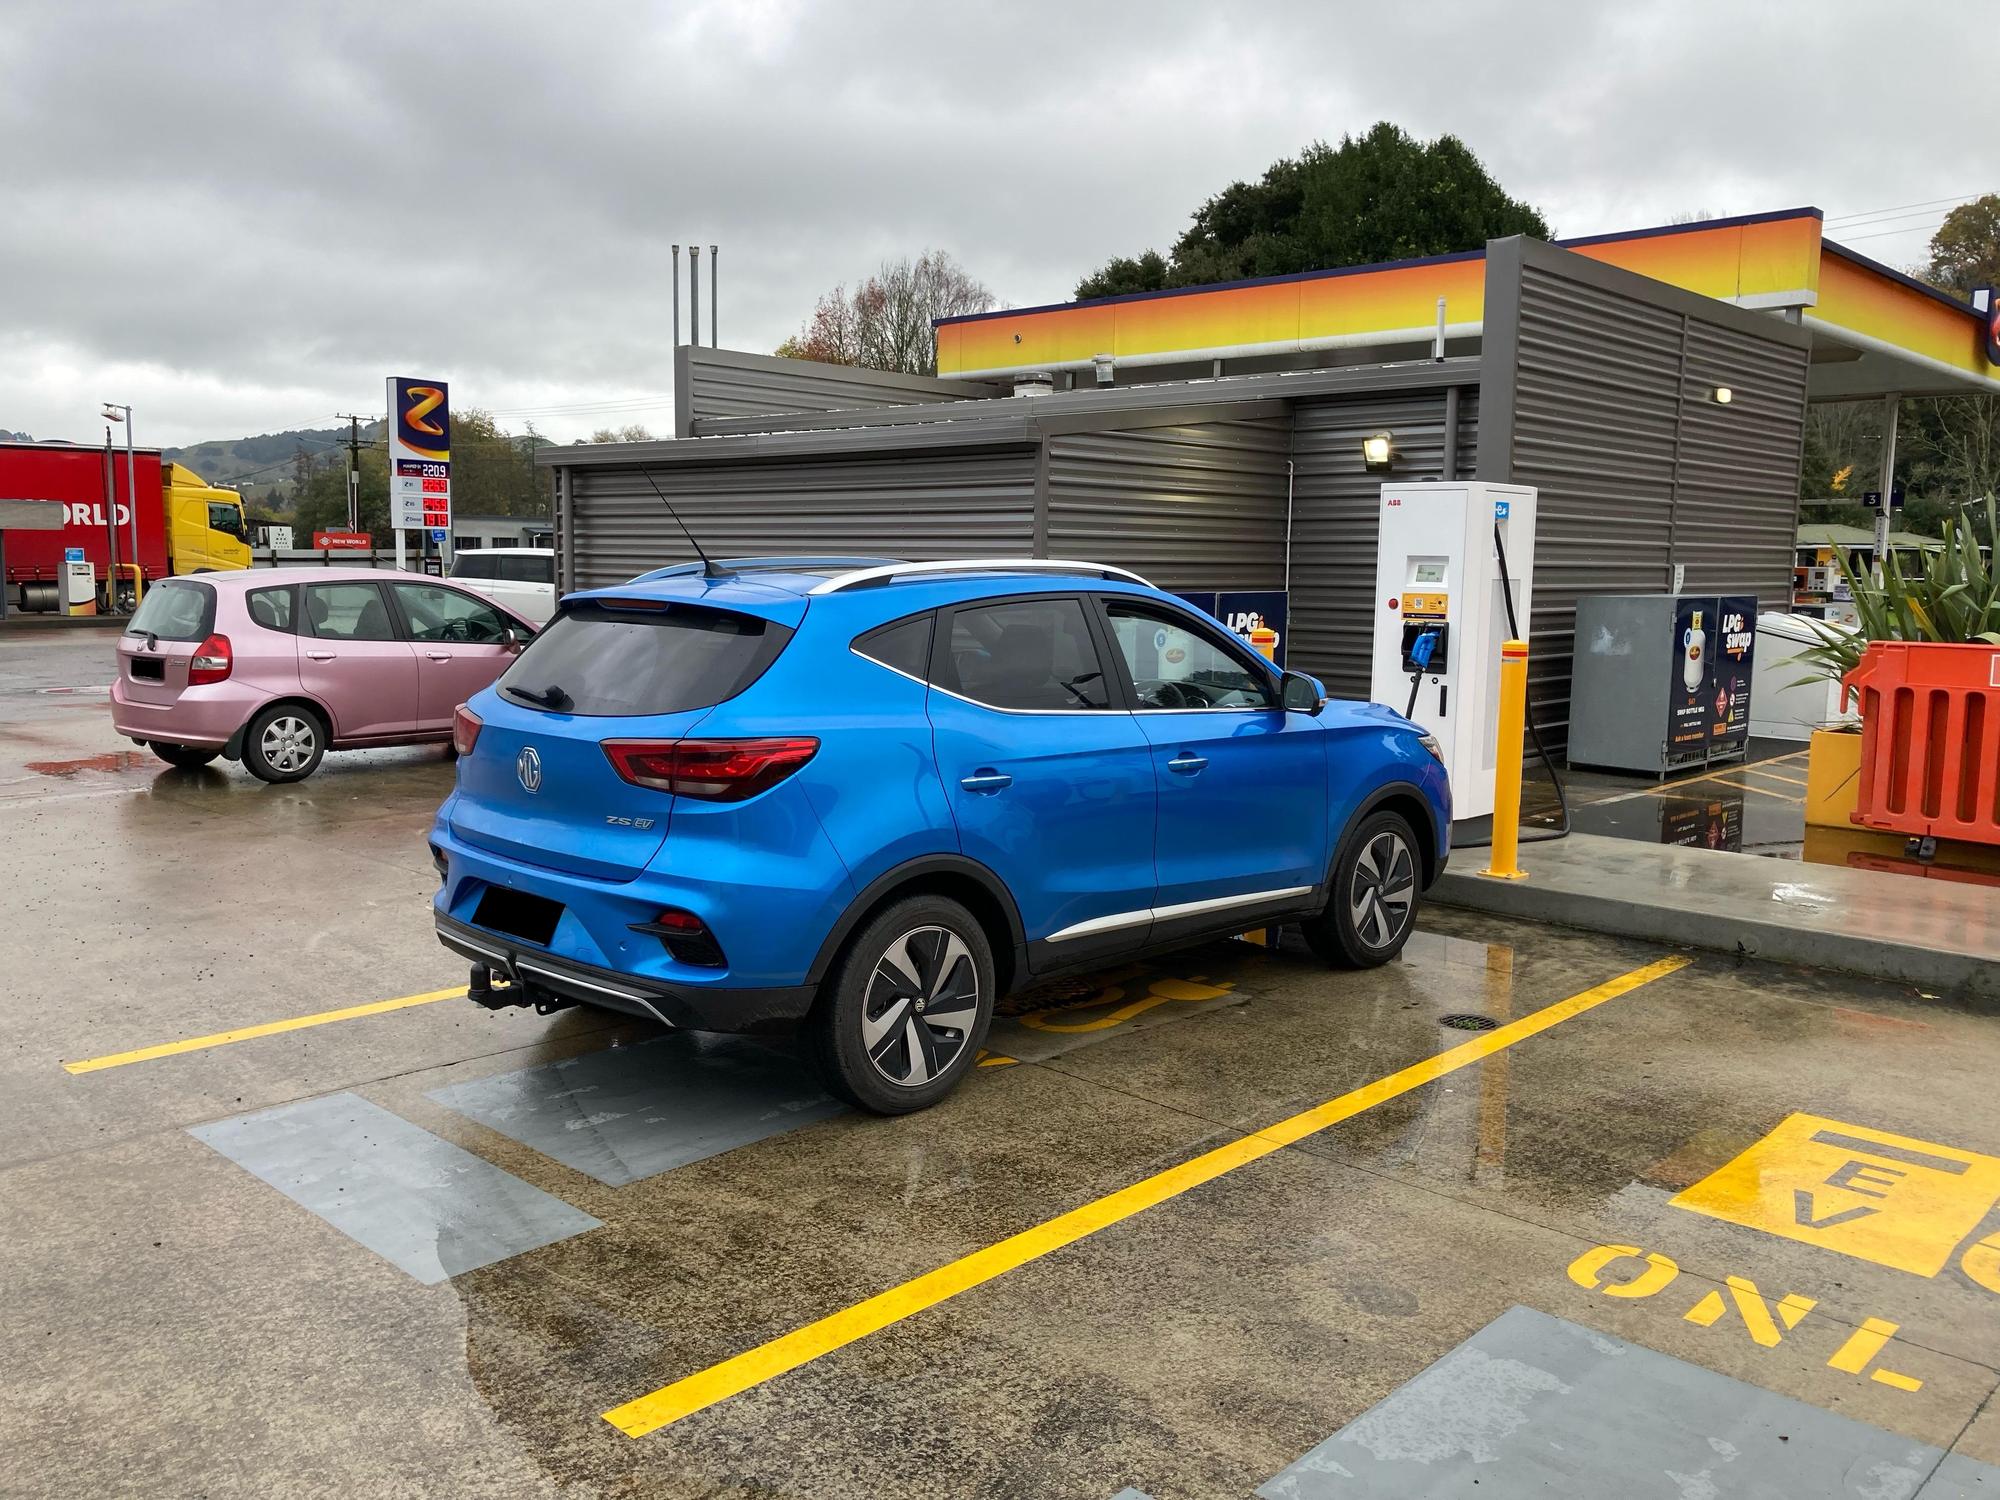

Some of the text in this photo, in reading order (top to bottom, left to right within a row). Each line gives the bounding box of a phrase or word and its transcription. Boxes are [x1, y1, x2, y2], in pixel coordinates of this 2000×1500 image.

[423, 464, 446, 478] 220.9
[1868, 495, 1876, 505] 3
[42, 499, 130, 526] RLD
[1227, 612, 1259, 632] LPG
[1722, 614, 1742, 633] LPG
[1726, 632, 1752, 653] swap
[518, 749, 540, 790] MG
[606, 816, 654, 829] ZS EV
